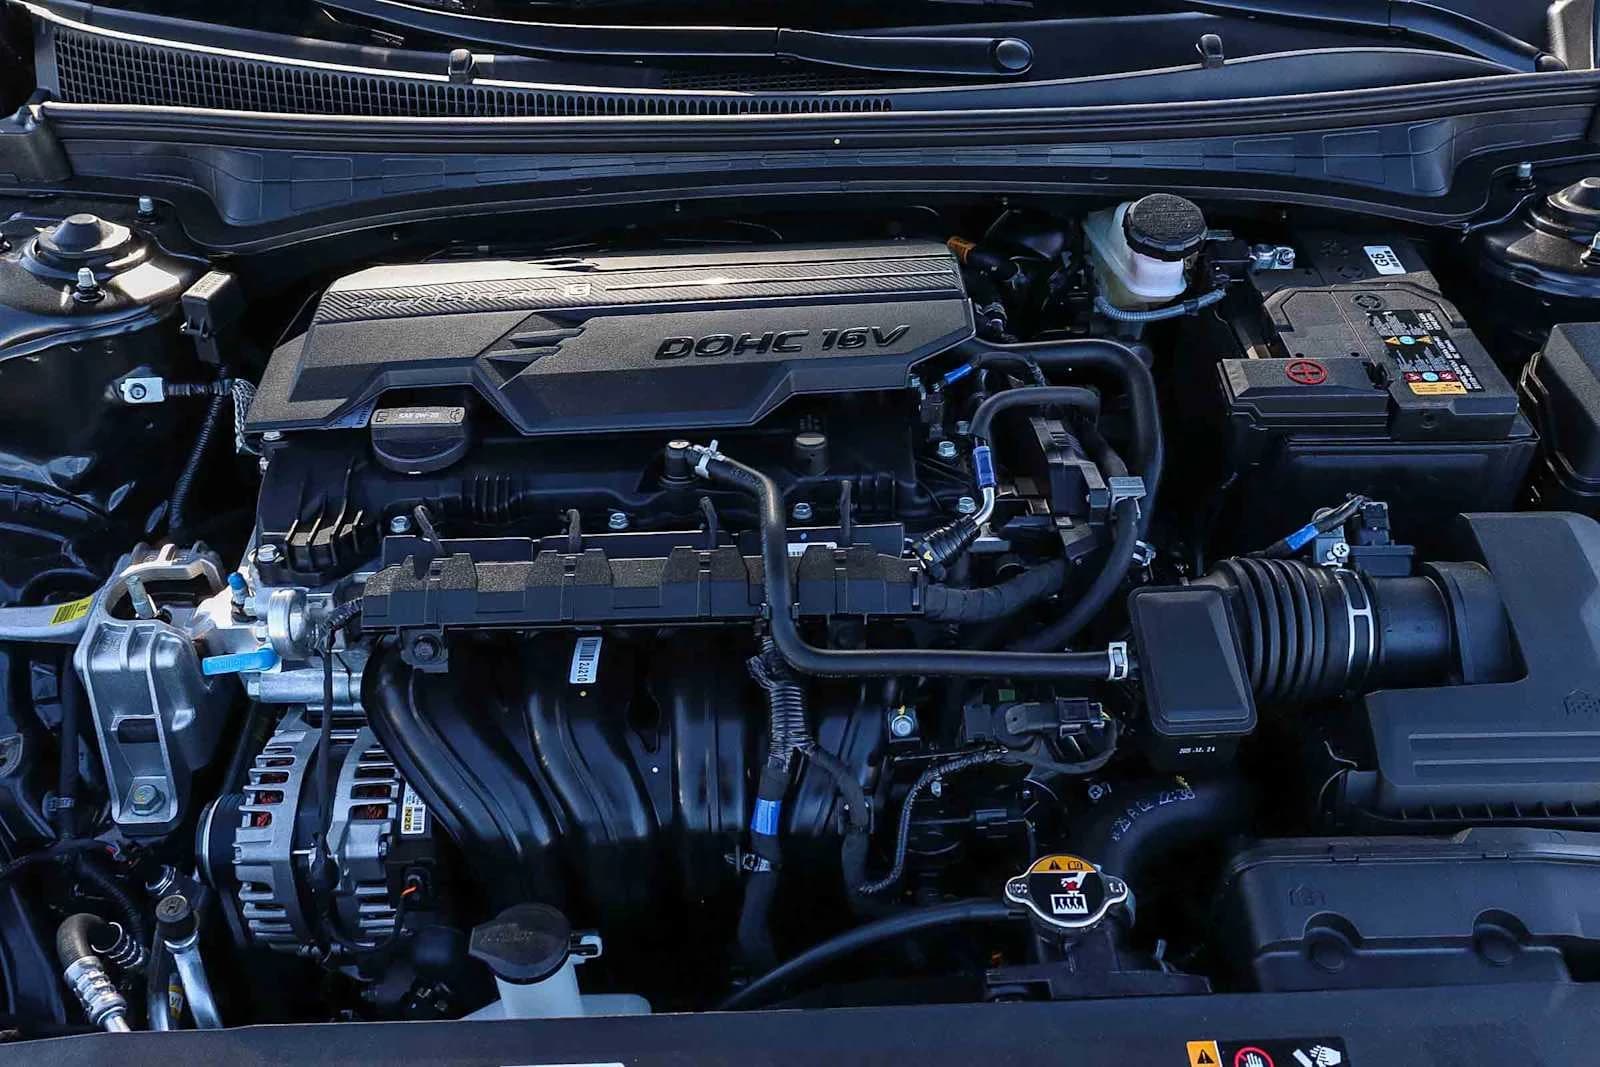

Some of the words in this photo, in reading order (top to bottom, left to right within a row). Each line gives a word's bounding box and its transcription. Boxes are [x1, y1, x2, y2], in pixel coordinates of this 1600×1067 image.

[1371, 253, 1390, 267] G6
[654, 329, 809, 360] DOHC
[821, 324, 911, 351] 16V
